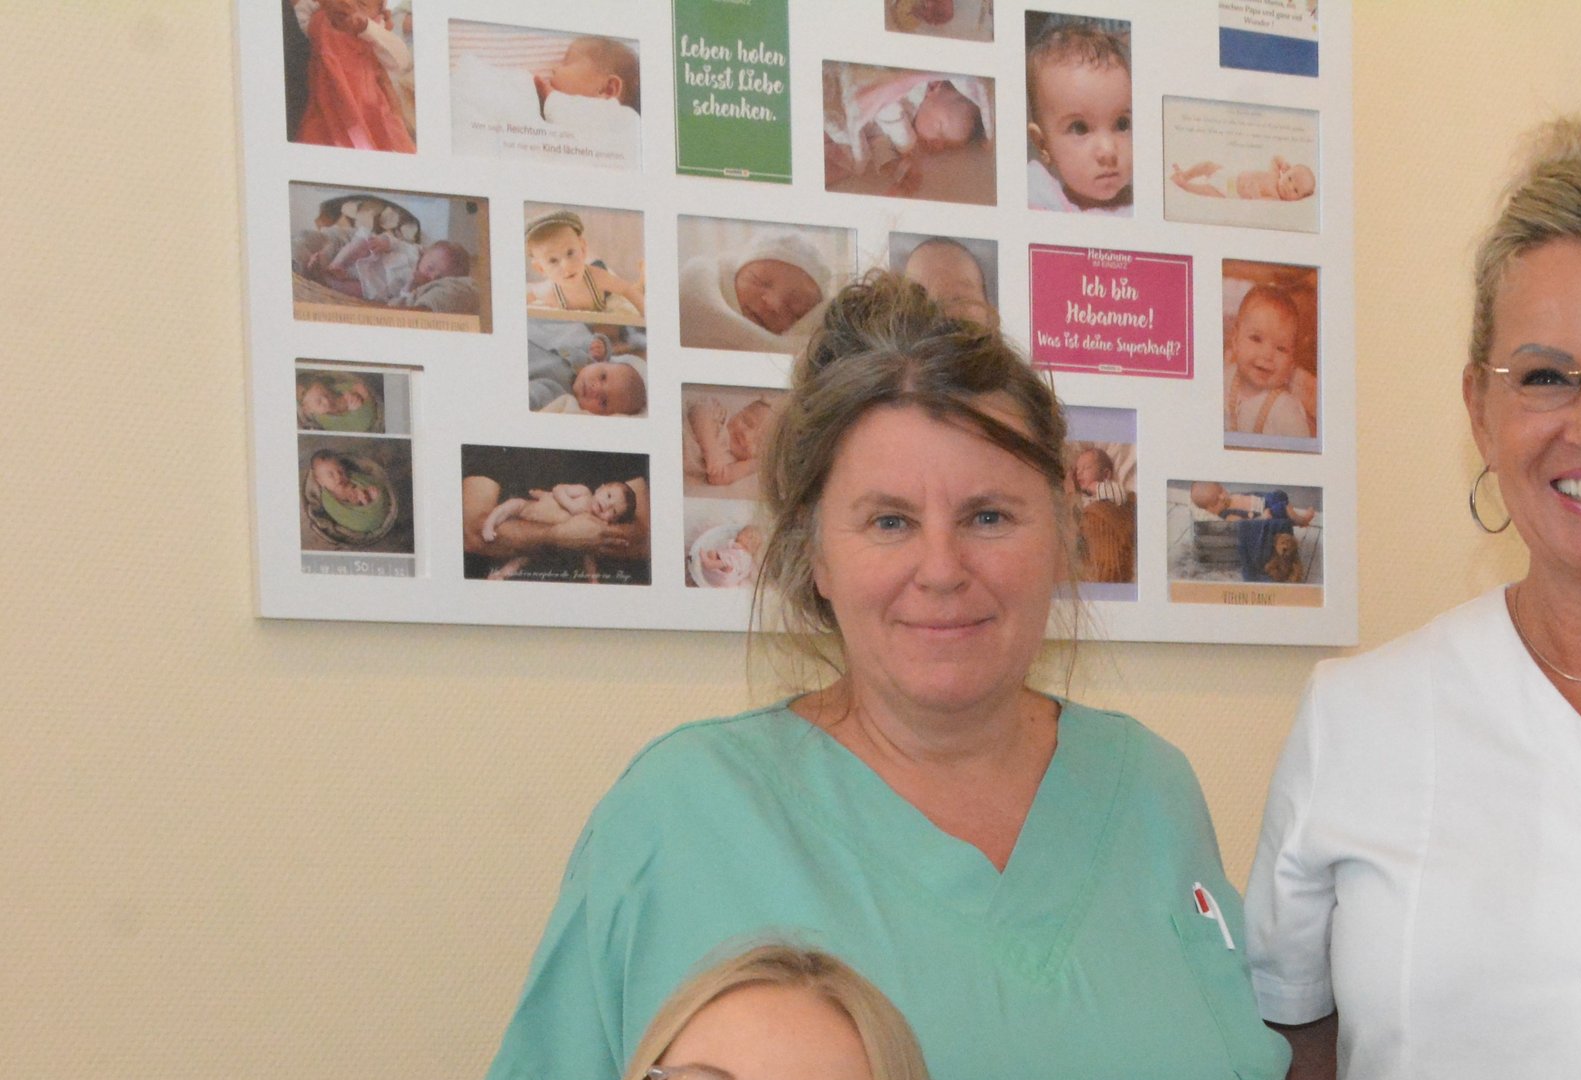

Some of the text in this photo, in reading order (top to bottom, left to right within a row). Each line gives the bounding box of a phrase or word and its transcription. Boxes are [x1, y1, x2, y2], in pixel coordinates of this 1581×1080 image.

[680, 34, 785, 66] Leben holen
[684, 62, 784, 95] heisst Liebe
[692, 93, 776, 121] schenken.
[506, 123, 547, 136] Reichtum
[543, 143, 562, 153] Kind
[563, 145, 593, 157] lächeln
[1088, 247, 1133, 263] Hebamme
[1082, 275, 1139, 301] Ich bin
[1066, 300, 1153, 329] Hebamme!
[1037, 330, 1181, 361] Was ist deine Superkraft?
[354, 560, 369, 572] 50
